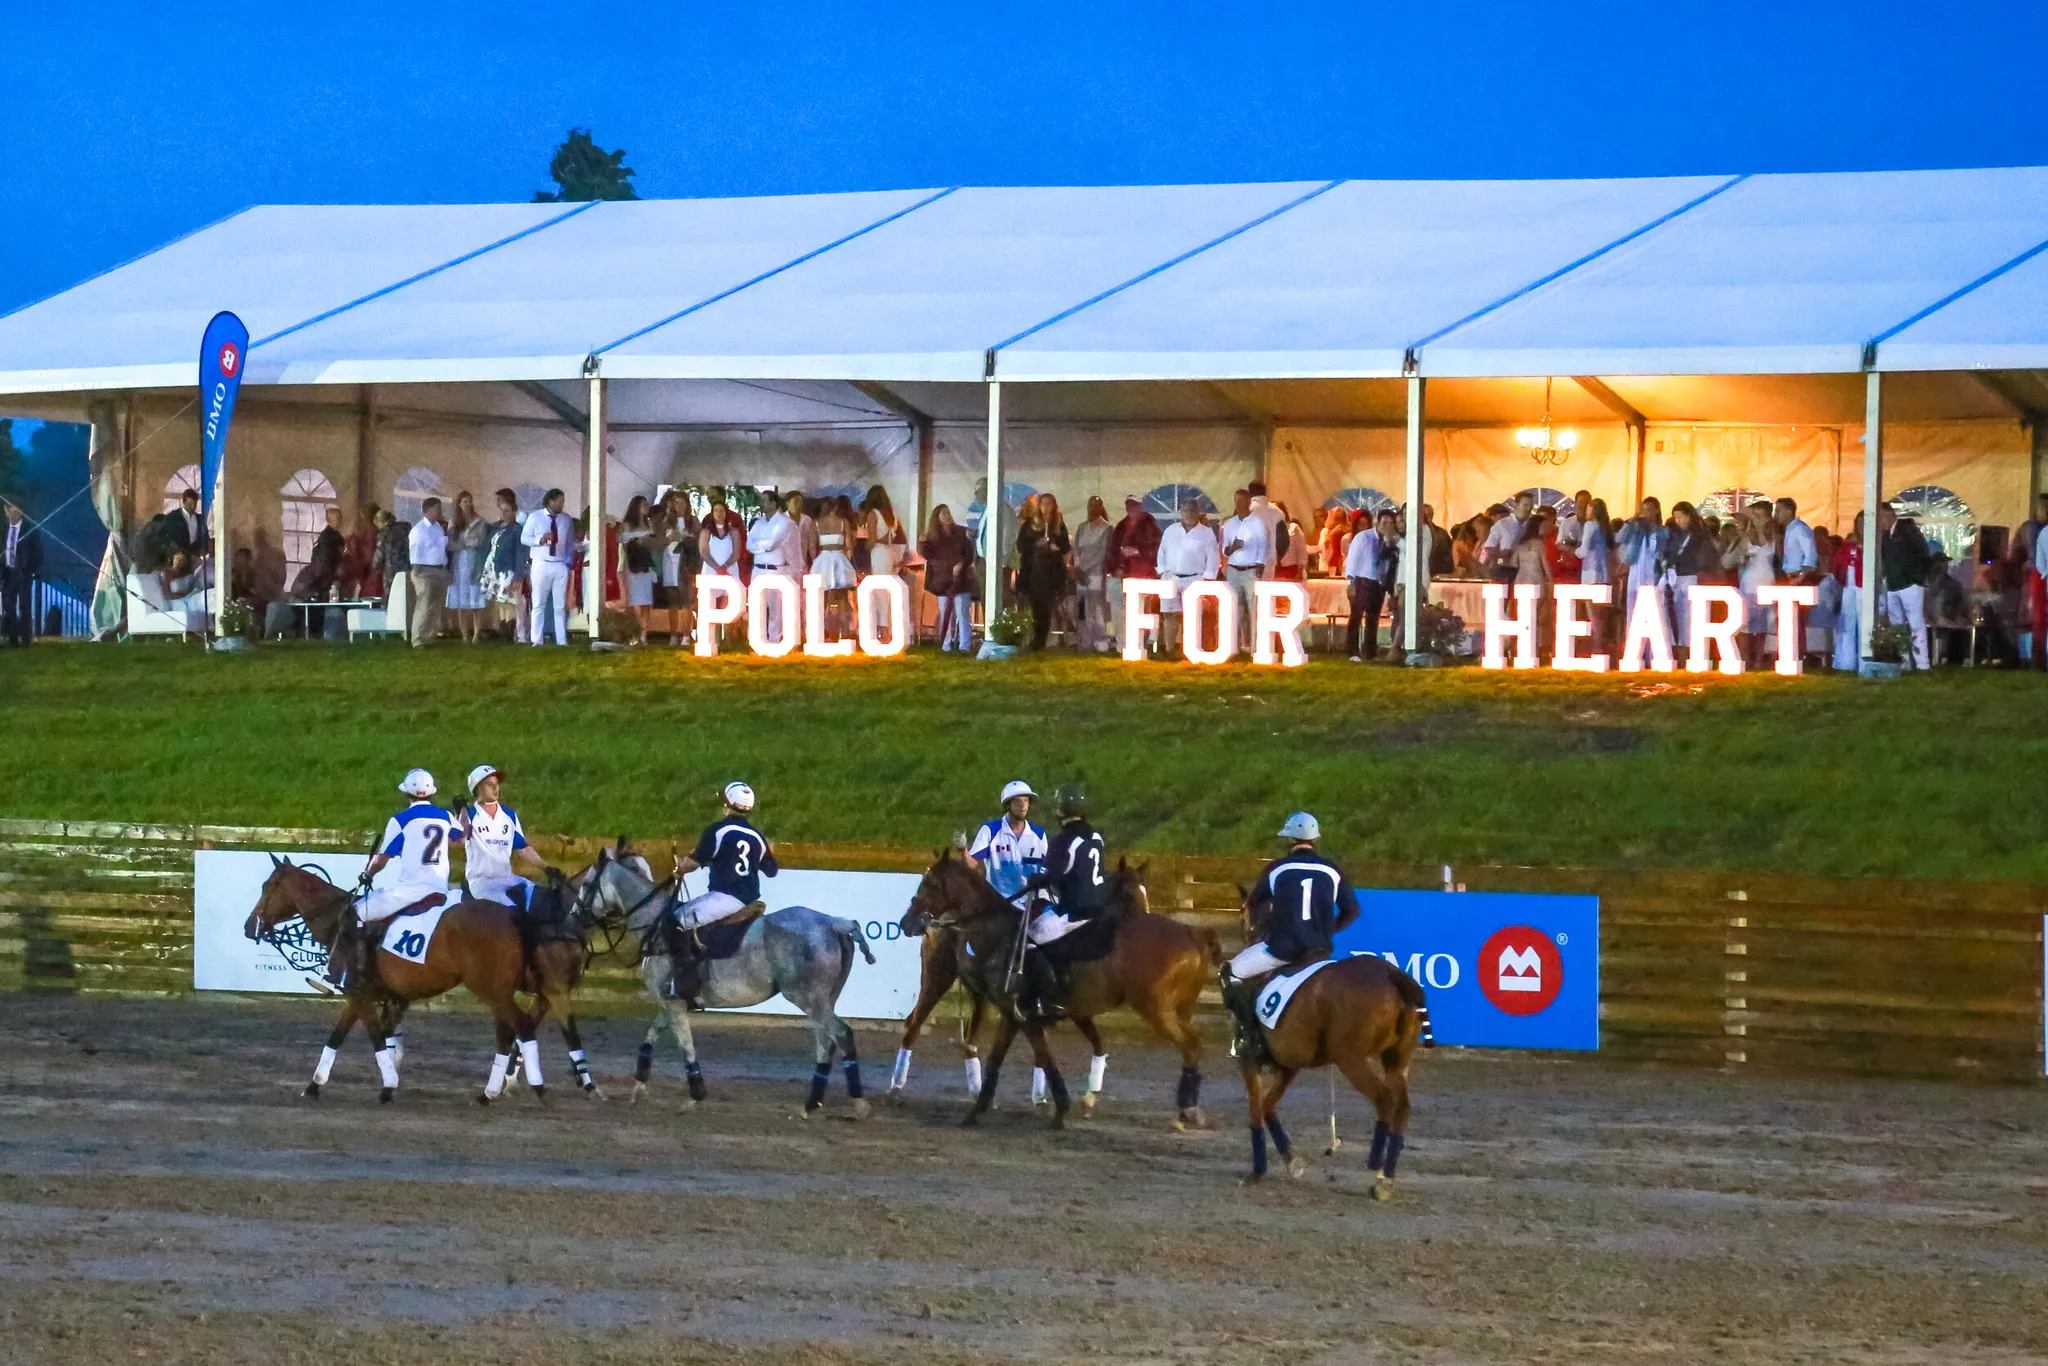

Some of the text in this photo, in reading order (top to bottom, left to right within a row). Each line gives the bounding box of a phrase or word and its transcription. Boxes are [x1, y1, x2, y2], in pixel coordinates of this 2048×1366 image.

[694, 574, 1818, 675] POLO FOR HEART
[422, 824, 444, 865] 2
[735, 840, 750, 876] 3
[1088, 847, 1104, 886] 2
[1300, 877, 1313, 921] 1
[392, 930, 425, 958] 10
[865, 920, 901, 940] OD
[291, 951, 328, 963] CLUBS
[1350, 950, 1460, 989] MO
[1261, 991, 1281, 1019] 9
